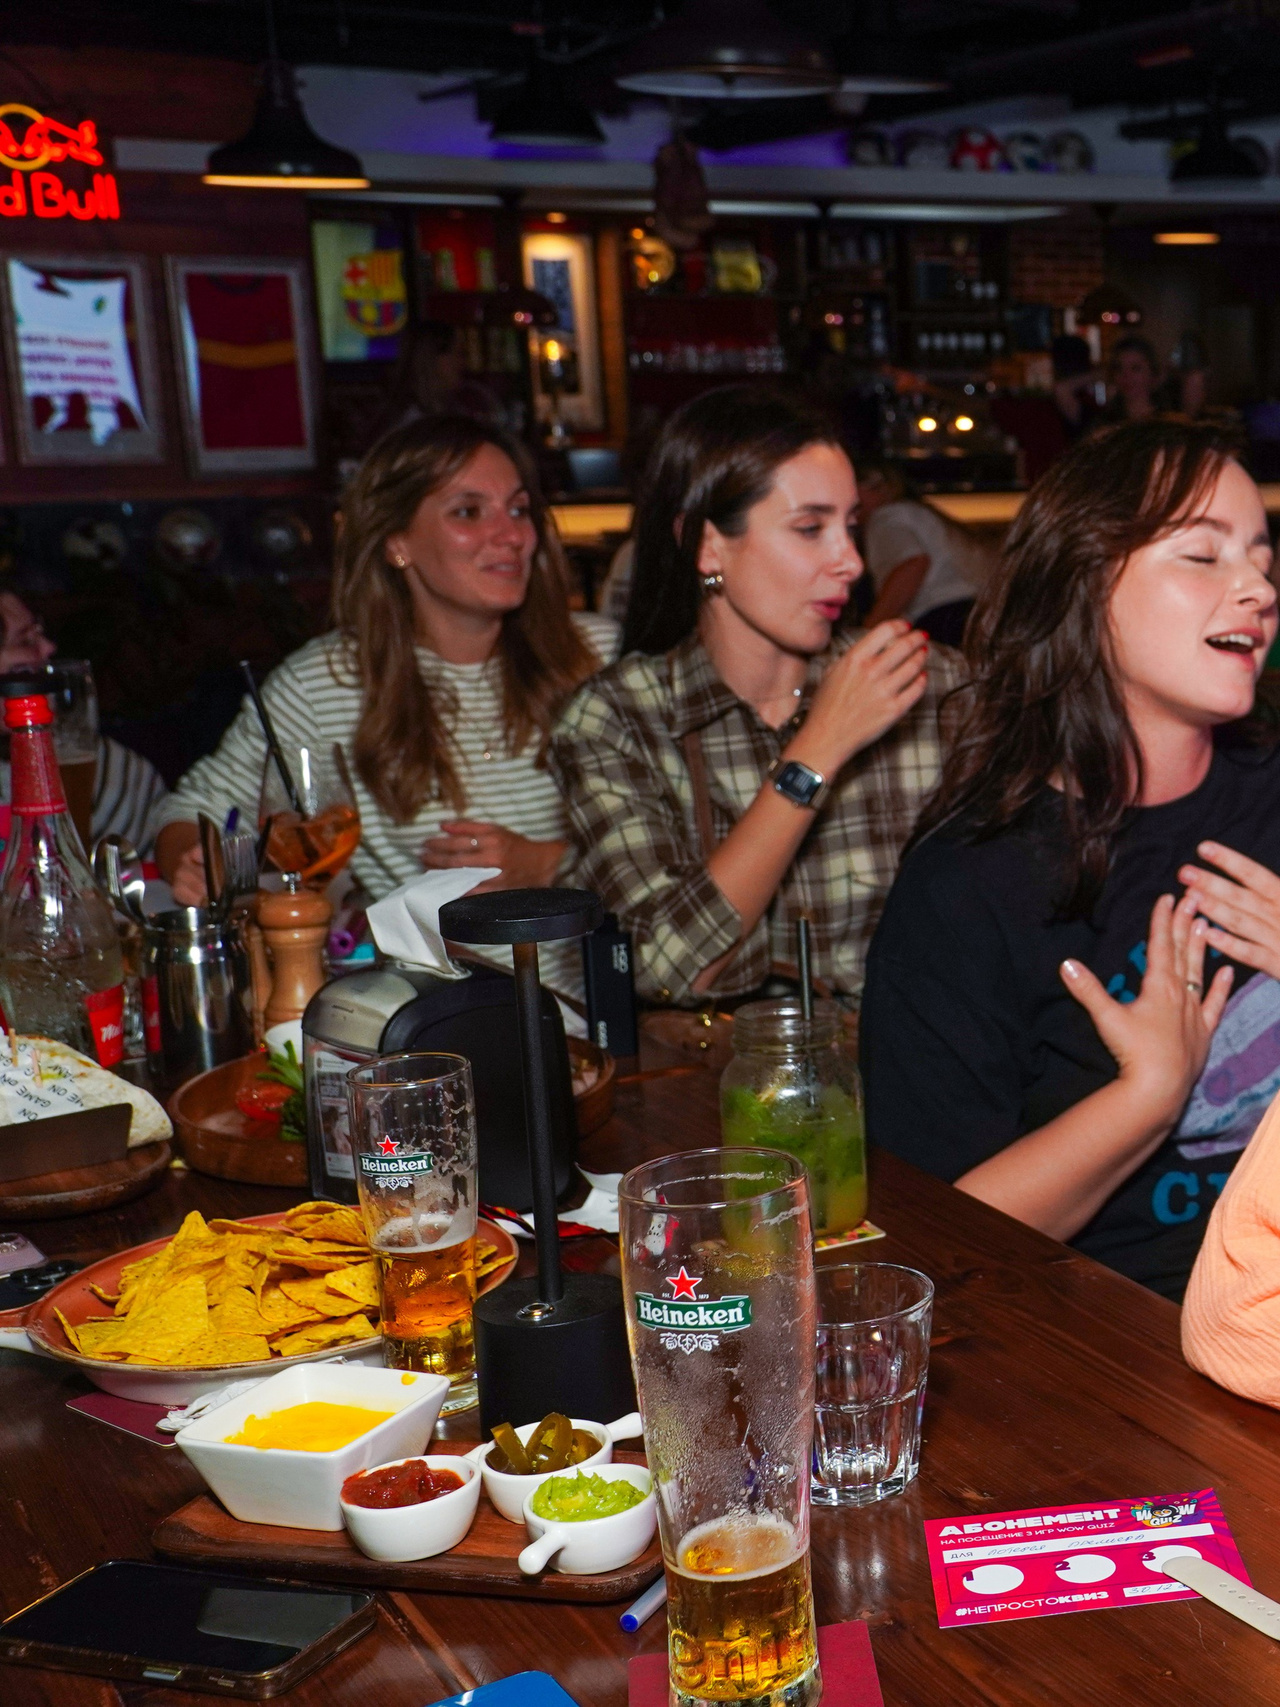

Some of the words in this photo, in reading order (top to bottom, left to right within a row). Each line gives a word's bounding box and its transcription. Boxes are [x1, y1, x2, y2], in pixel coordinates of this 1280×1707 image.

[30, 171, 120, 220] Bull
[16, 1086, 51, 1108] GAME
[361, 1157, 428, 1173] Heineken
[639, 1299, 745, 1326] Heineken
[939, 1508, 1121, 1537] АБОНЕМЕНТ
[940, 1538, 956, 1546] НА
[957, 1531, 1024, 1544] ПОСЕЩЕНИЕ
[1034, 1528, 1054, 1536] ИГР
[1056, 1525, 1085, 1533] WOW
[1087, 1521, 1116, 1530] QUIZ
[1053, 1561, 1071, 1572] 2
[1140, 1551, 1156, 1562] 3
[962, 1570, 974, 1582] 1
[955, 1591, 1110, 1617] #НЕПРОСТОКВИЗ
